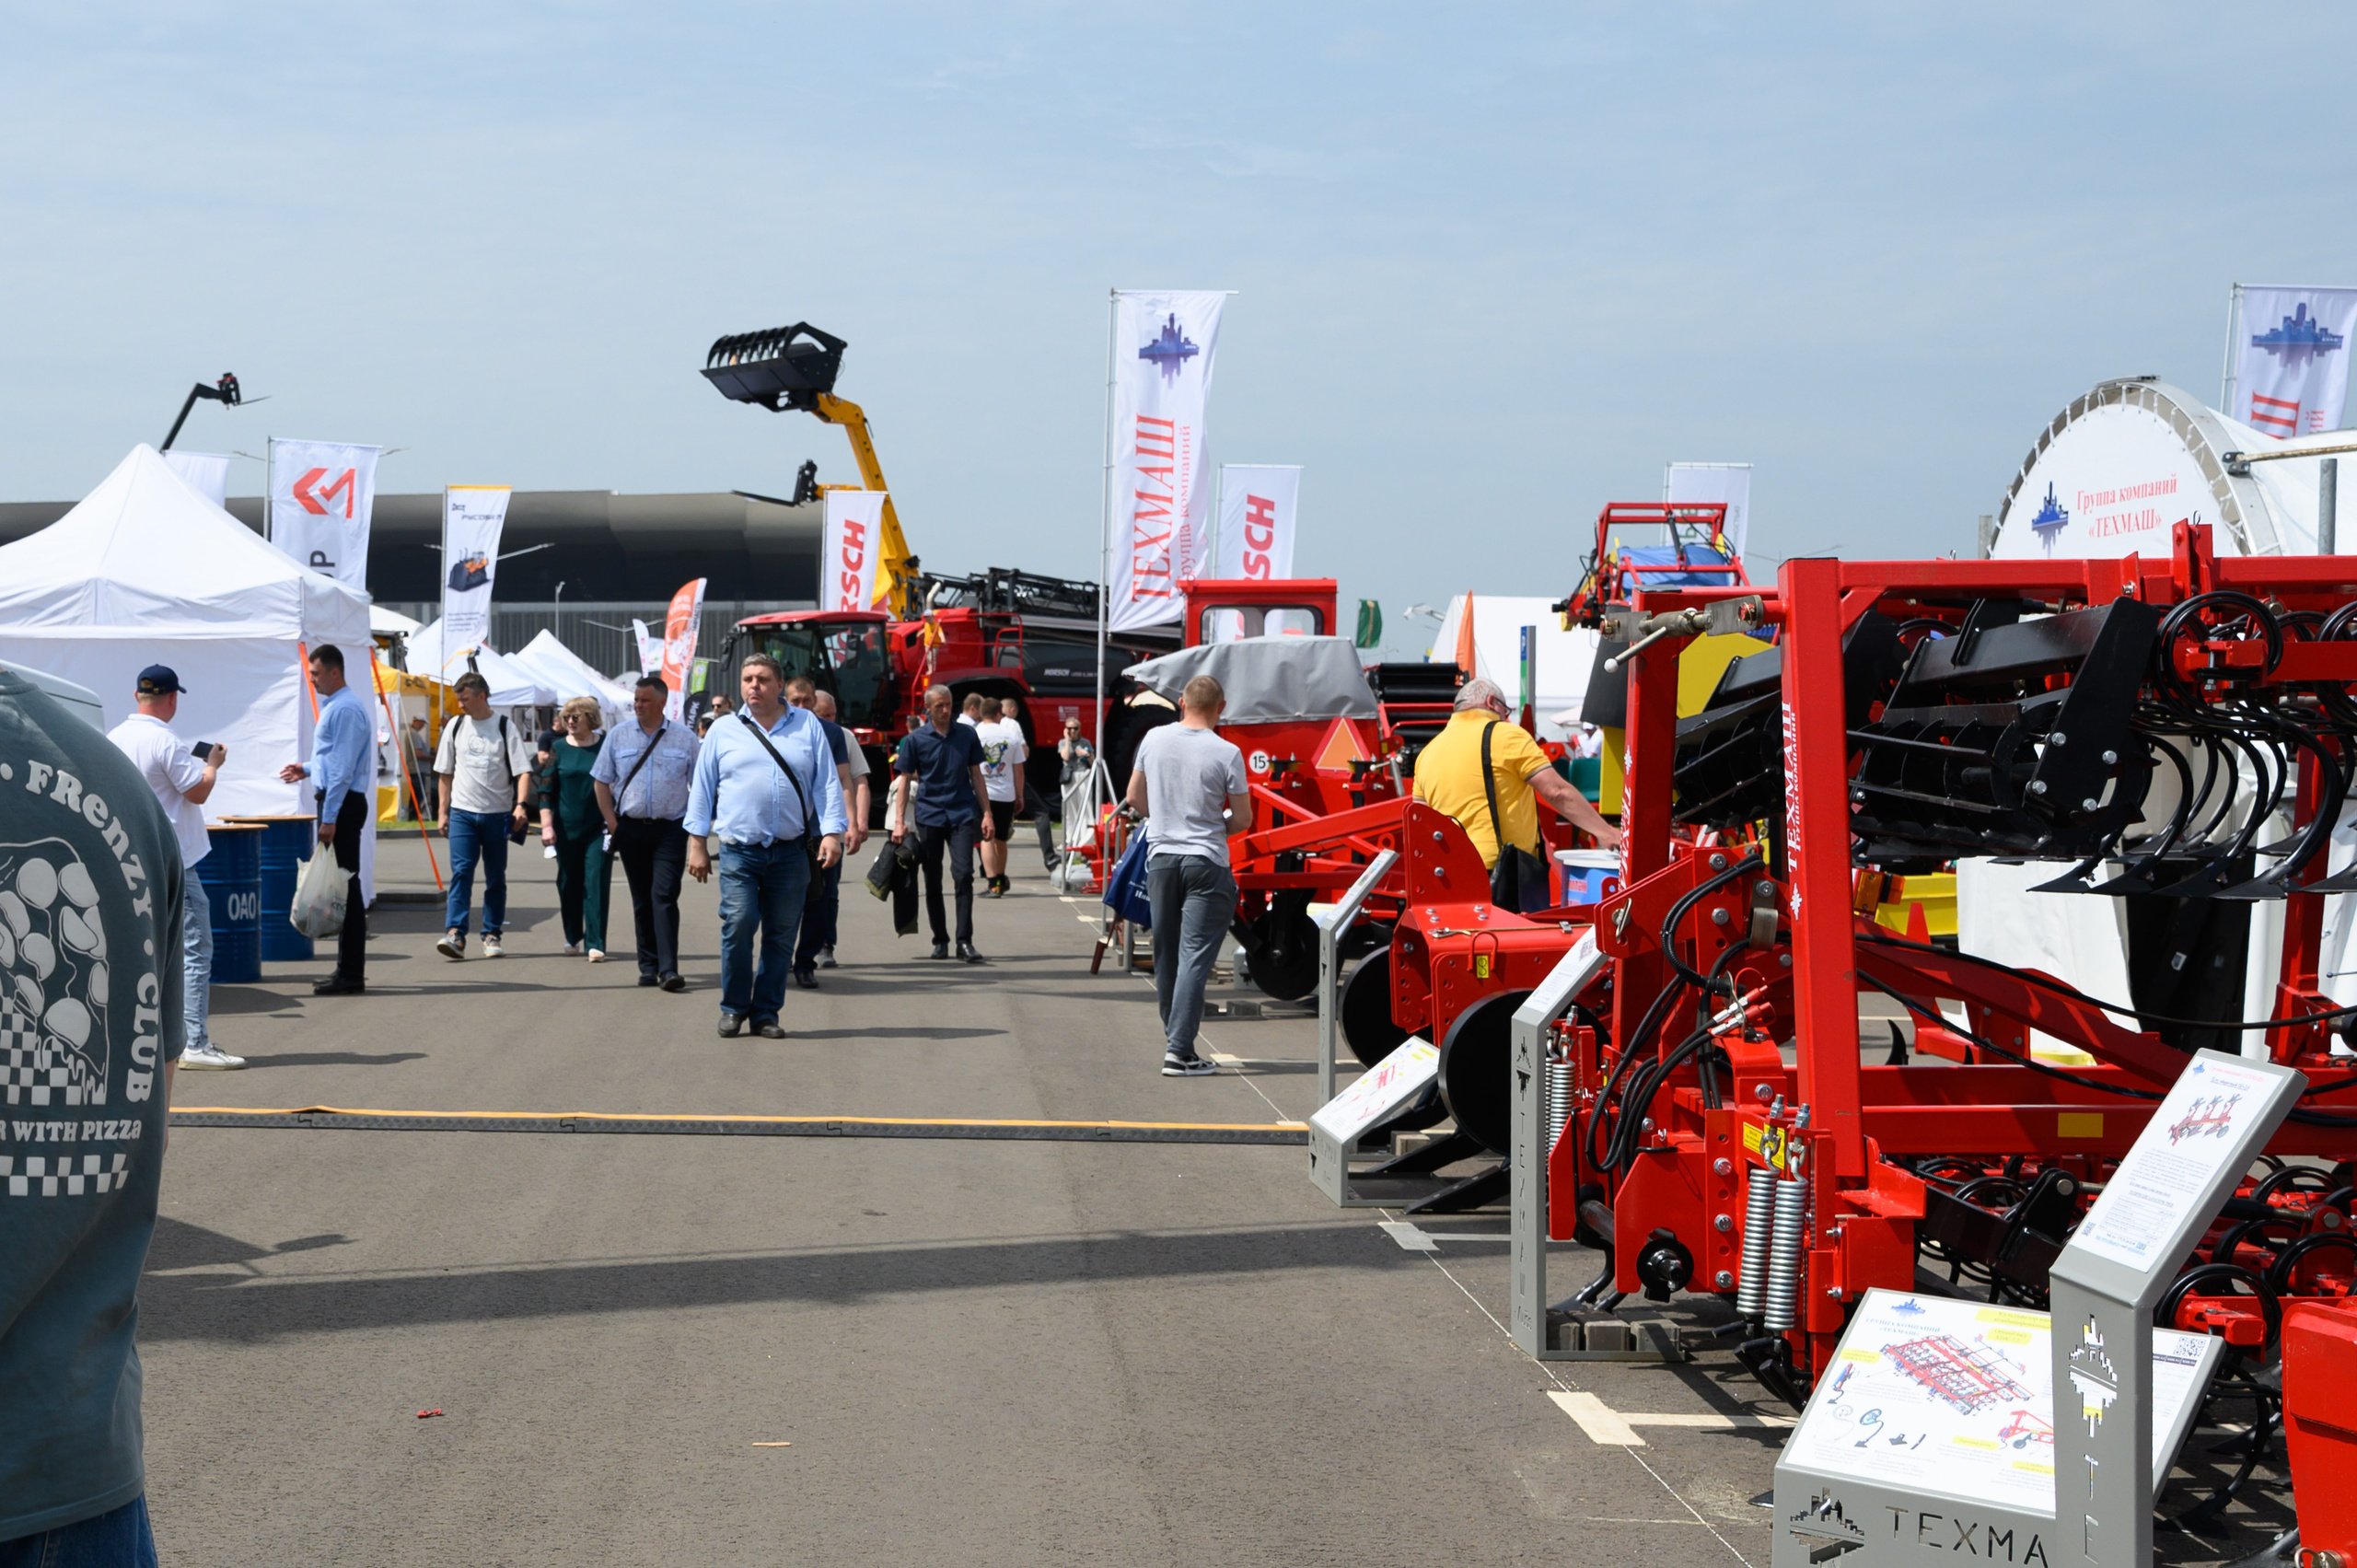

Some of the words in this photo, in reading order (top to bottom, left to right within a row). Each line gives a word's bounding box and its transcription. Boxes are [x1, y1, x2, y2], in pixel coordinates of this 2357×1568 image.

[1131, 412, 1175, 603] ТЕХМАШ
[2077, 490, 2117, 515] Группа
[2119, 472, 2177, 503] компаний
[2088, 508, 2162, 538] «ТЕХМАШ»
[1179, 523, 1196, 576] руппа
[1253, 755, 1266, 769] 15
[1782, 702, 1799, 873] ТЕХМАШ
[125, 972, 159, 1103] CLUB
[12, 1121, 78, 1142] WITH
